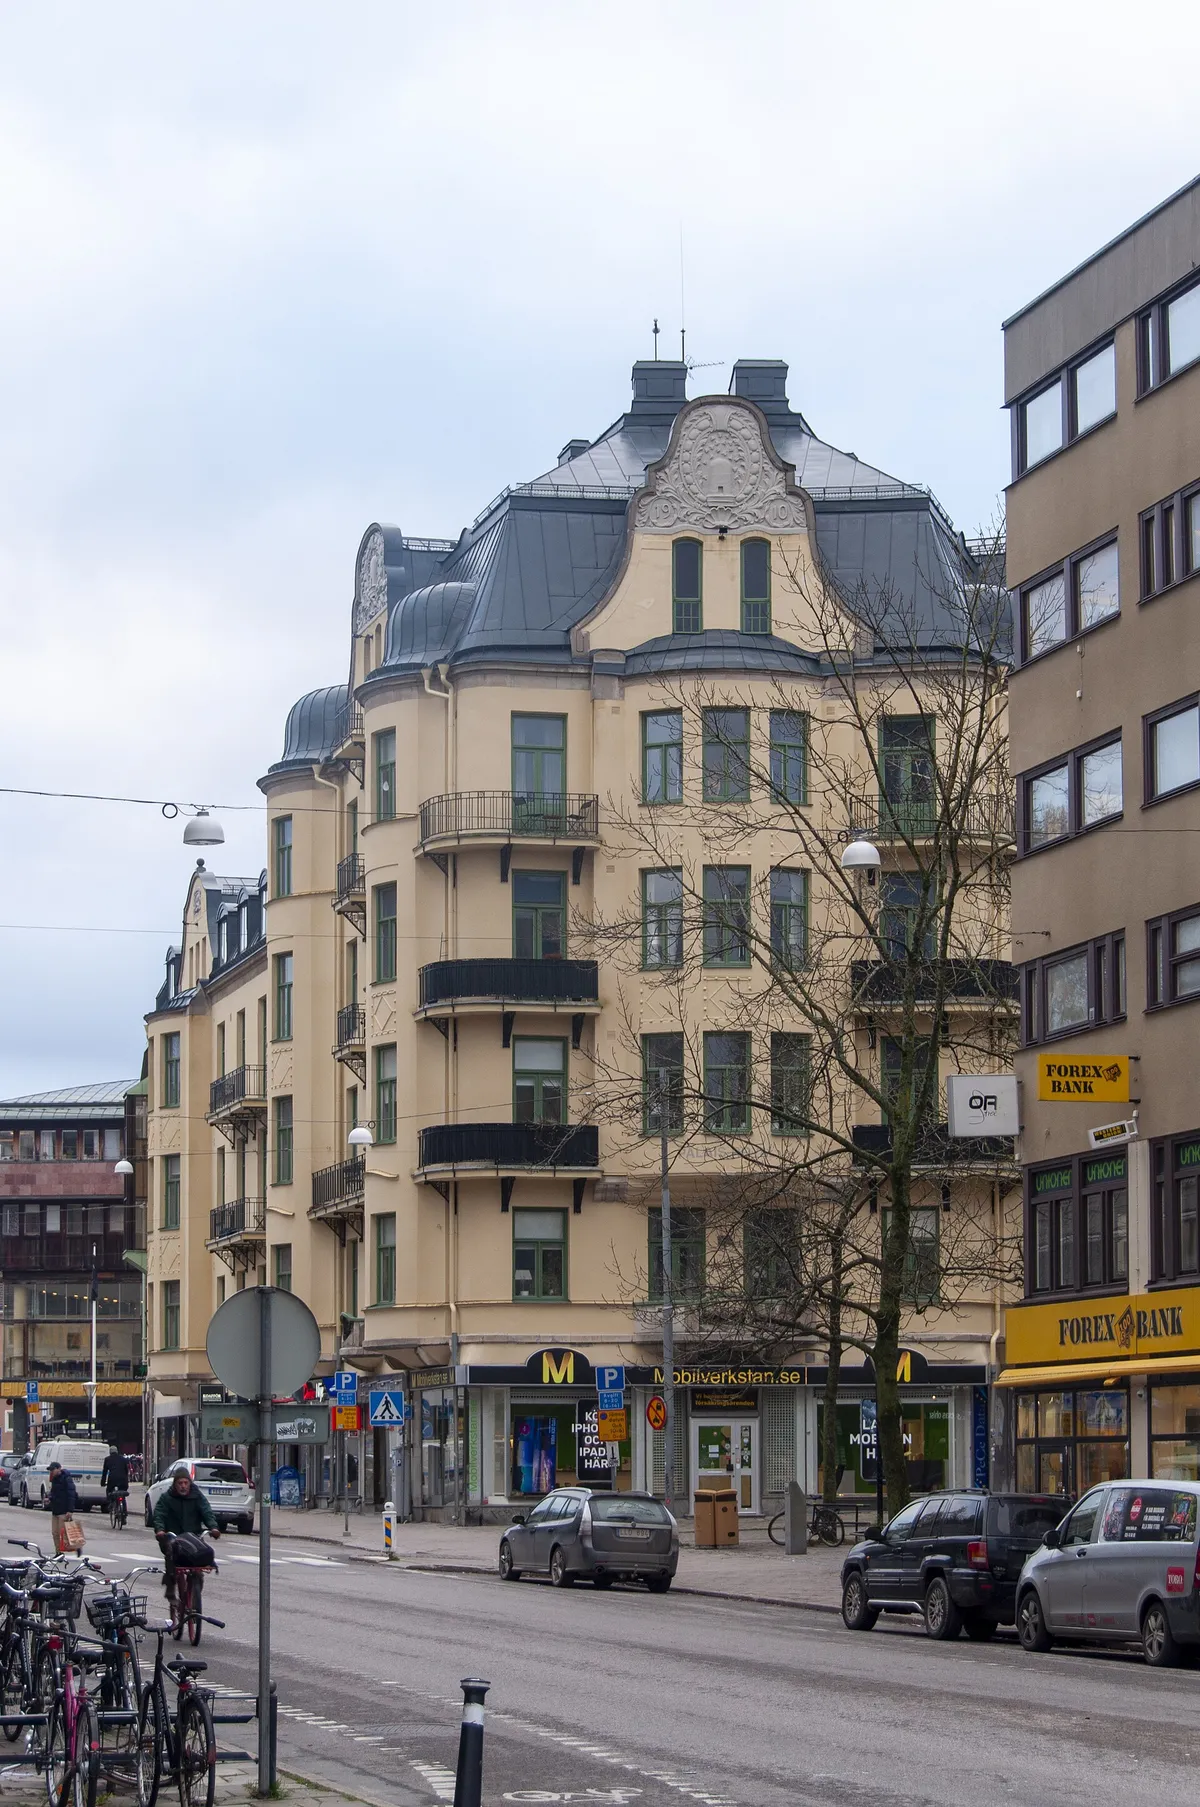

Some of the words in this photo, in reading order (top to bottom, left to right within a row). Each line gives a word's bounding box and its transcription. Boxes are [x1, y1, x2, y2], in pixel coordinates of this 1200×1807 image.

[655, 504, 670, 519] 19
[772, 505, 788, 520] 10
[1046, 1064, 1102, 1078] FOREX
[1051, 1080, 1094, 1093] BANK
[1058, 1313, 1116, 1346] FOREX
[1136, 1306, 1184, 1339] BANK
[542, 1351, 574, 1384] M
[653, 1367, 801, 1385] Mobilverkstan.se
[341, 1373, 353, 1390] P
[604, 1368, 618, 1389] P
[29, 1385, 36, 1393] P
[975, 1441, 986, 1477] PeCe
[1168, 1574, 1183, 1585] TORO
